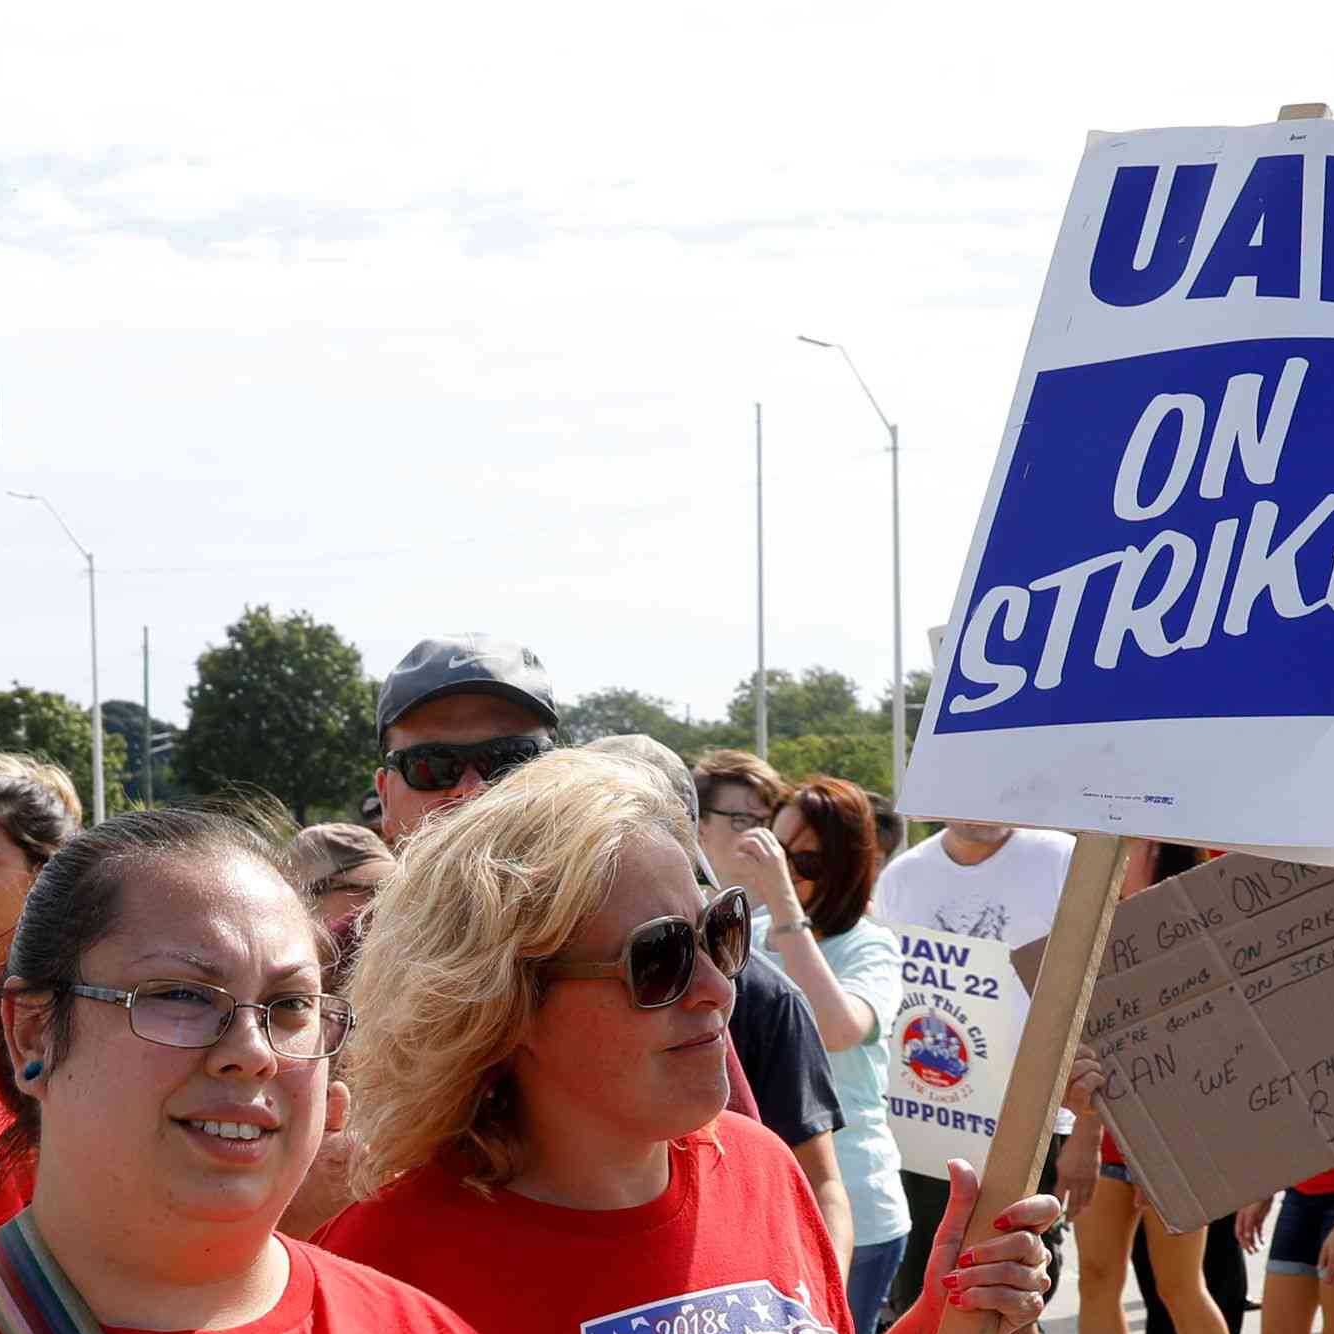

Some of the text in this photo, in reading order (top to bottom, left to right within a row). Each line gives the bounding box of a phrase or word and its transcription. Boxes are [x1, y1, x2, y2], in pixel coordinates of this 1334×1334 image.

[1113, 356, 1310, 522] ON
[1156, 906, 1224, 950] GOING
[964, 974, 999, 1000] 22
[1157, 967, 1212, 1007] GOING
[896, 991, 988, 1060] uilt This City
[1166, 1000, 1215, 1033] GOING
[1100, 1042, 1178, 1101] CAN
[1248, 1070, 1297, 1114] GET
[881, 1094, 997, 1138] UPPORTS
